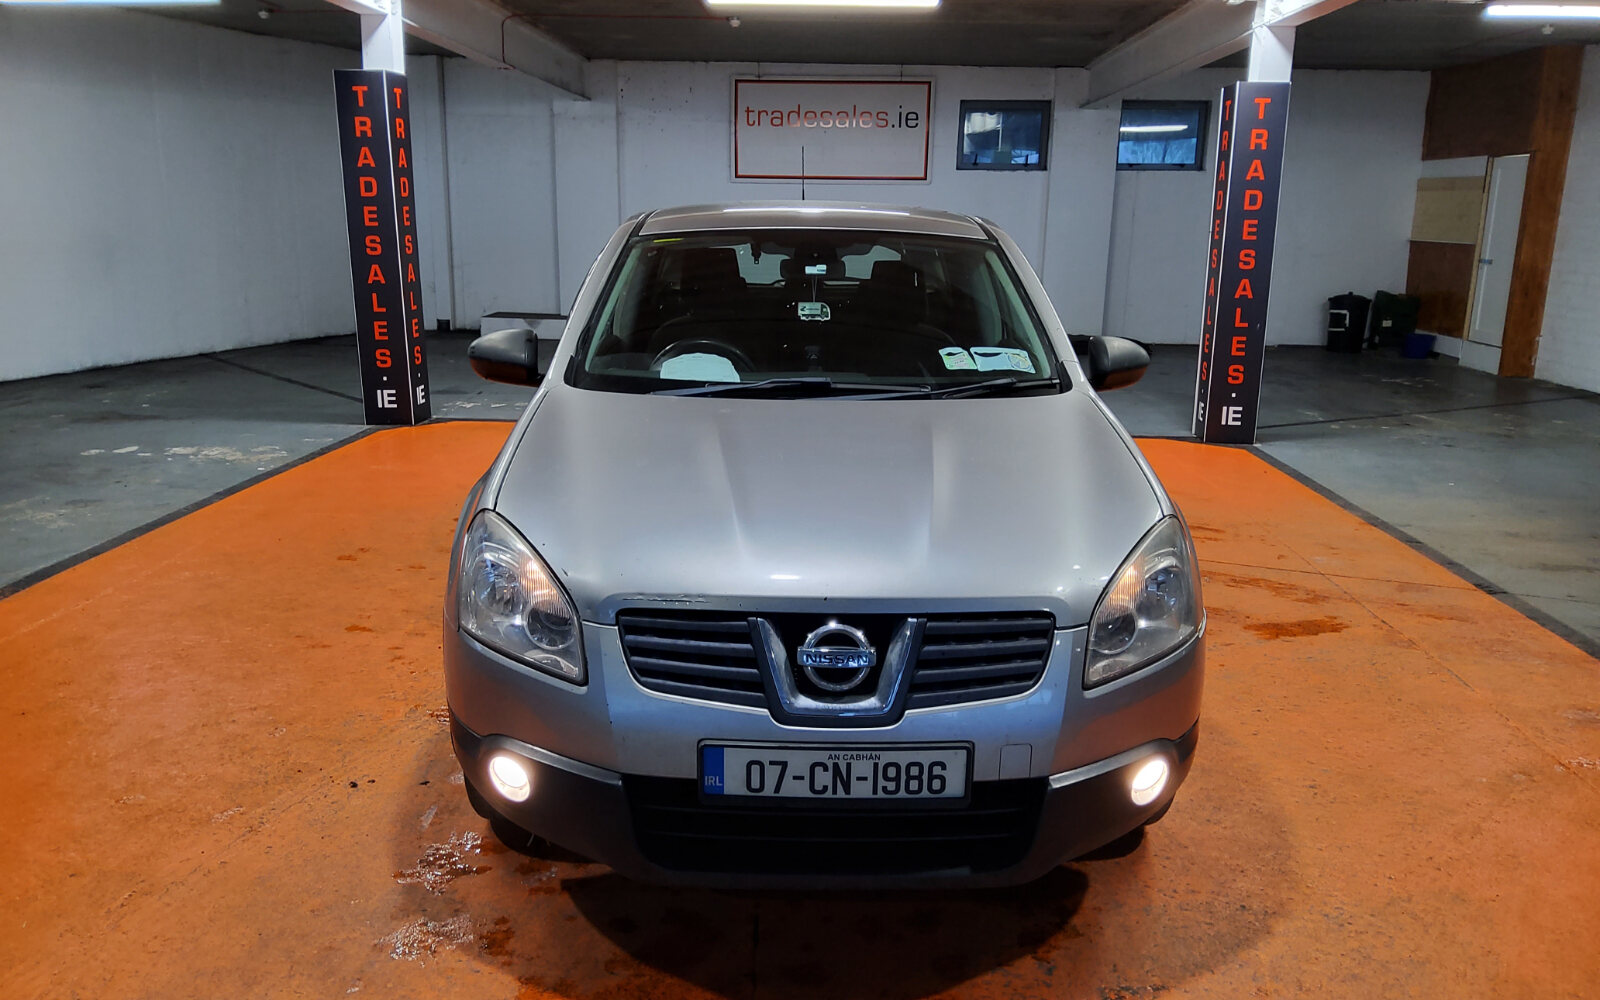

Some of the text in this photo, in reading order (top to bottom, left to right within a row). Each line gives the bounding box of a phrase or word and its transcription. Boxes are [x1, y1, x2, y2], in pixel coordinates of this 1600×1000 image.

[745, 104, 919, 128] tradesales.ie
[804, 653, 869, 665] NISSAN
[828, 753, 840, 761] AN
[704, 775, 723, 786] IRL
[745, 760, 947, 796] 07-CN-1986
